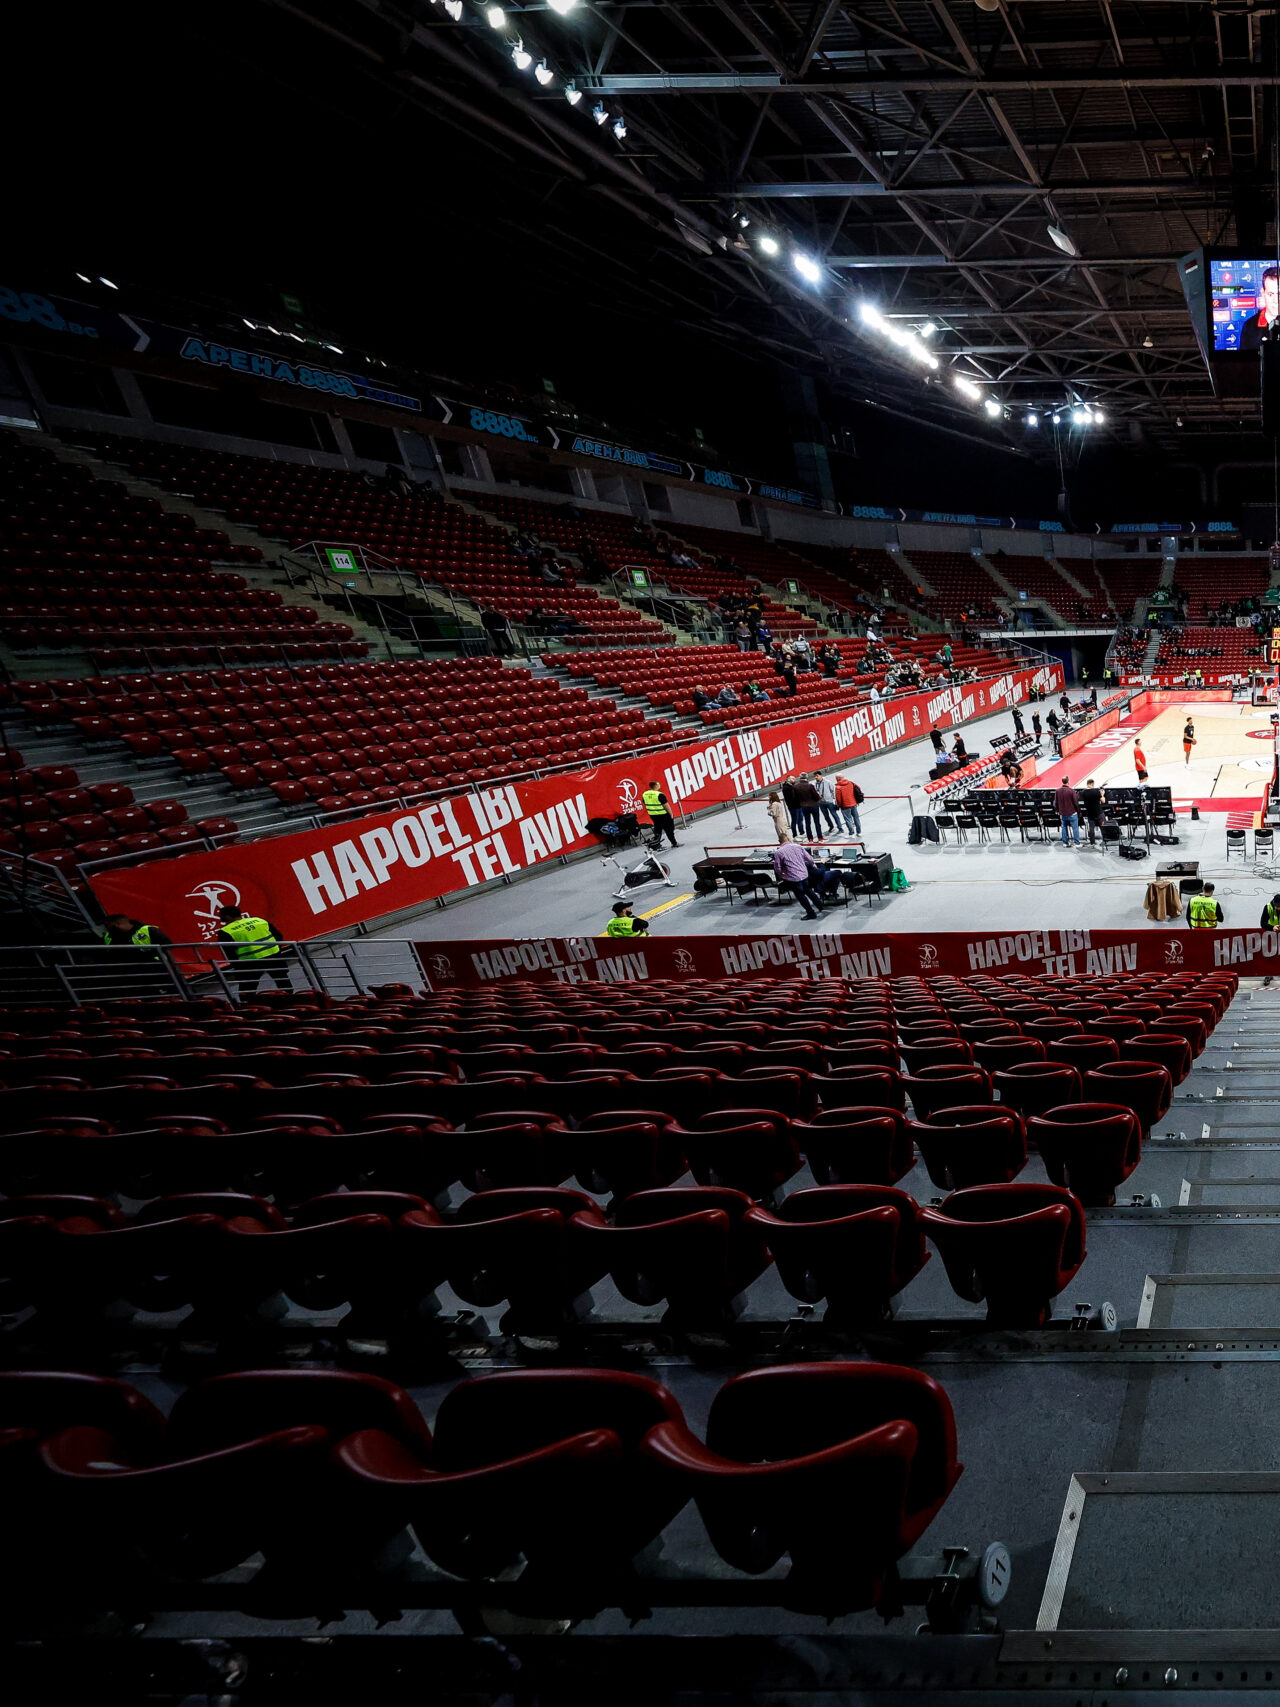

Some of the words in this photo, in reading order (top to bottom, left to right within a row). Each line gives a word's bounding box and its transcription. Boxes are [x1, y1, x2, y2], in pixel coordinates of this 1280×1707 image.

[183, 340, 296, 382] АРЕНА
[298, 367, 358, 397] 8888
[572, 438, 623, 460] АРЕНА
[334, 557, 350, 566] 114
[831, 707, 874, 754] HAPOEL
[871, 702, 887, 727] IBI
[927, 690, 956, 724] HAPOEL
[950, 706, 962, 725] TEL
[960, 693, 976, 722] AVIV
[867, 729, 886, 752] TEL
[884, 711, 906, 746] AVIV
[663, 736, 740, 803] HAPOEL
[736, 731, 764, 763] IBI
[730, 761, 761, 797] TEL
[760, 739, 796, 787] AVIV
[290, 799, 472, 915] HAPOEL
[467, 785, 524, 833] IBI
[451, 840, 521, 887] TEL
[520, 792, 592, 866] AVIV
[470, 938, 564, 981] HAPOEL
[563, 938, 599, 963] IBI
[595, 951, 650, 983] AVIV
[720, 934, 803, 976] HAPOEL
[802, 933, 845, 957] IBI
[839, 947, 892, 980] AVIV
[966, 929, 1057, 971] HAPOEL
[1054, 928, 1094, 954] IBI
[1085, 942, 1138, 977] AVIV
[1107, 1309, 1115, 1326] 10
